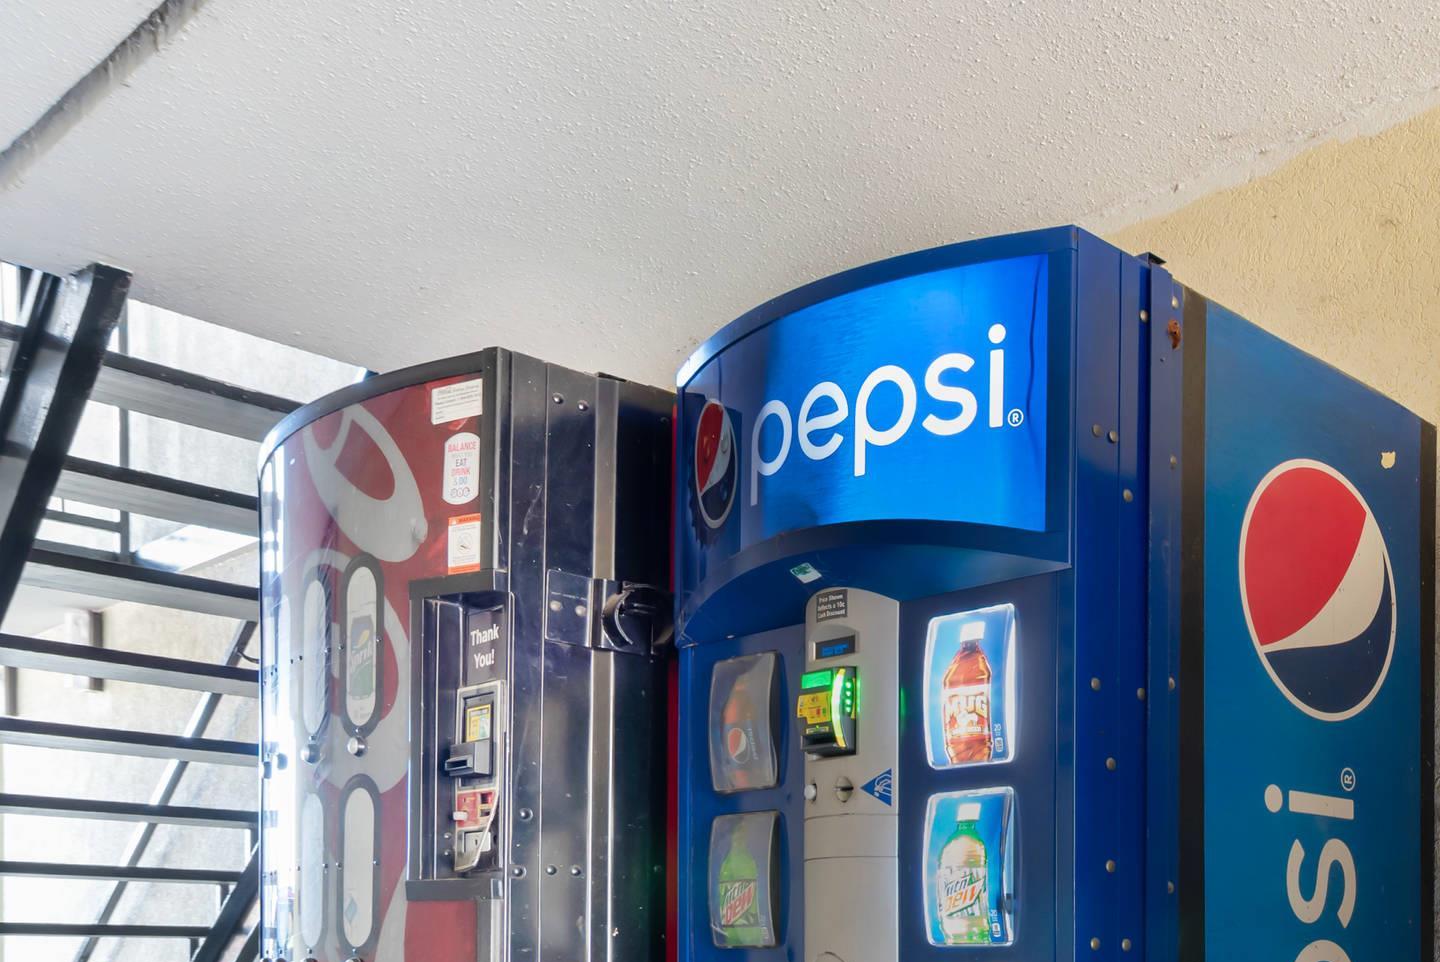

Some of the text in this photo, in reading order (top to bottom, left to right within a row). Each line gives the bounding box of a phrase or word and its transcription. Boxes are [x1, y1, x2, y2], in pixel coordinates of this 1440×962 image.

[750, 324, 1005, 507] pepsi
[448, 441, 477, 453] BALANCE
[455, 458, 467, 467] EAT
[471, 624, 499, 646] Thank
[474, 649, 495, 670] You!
